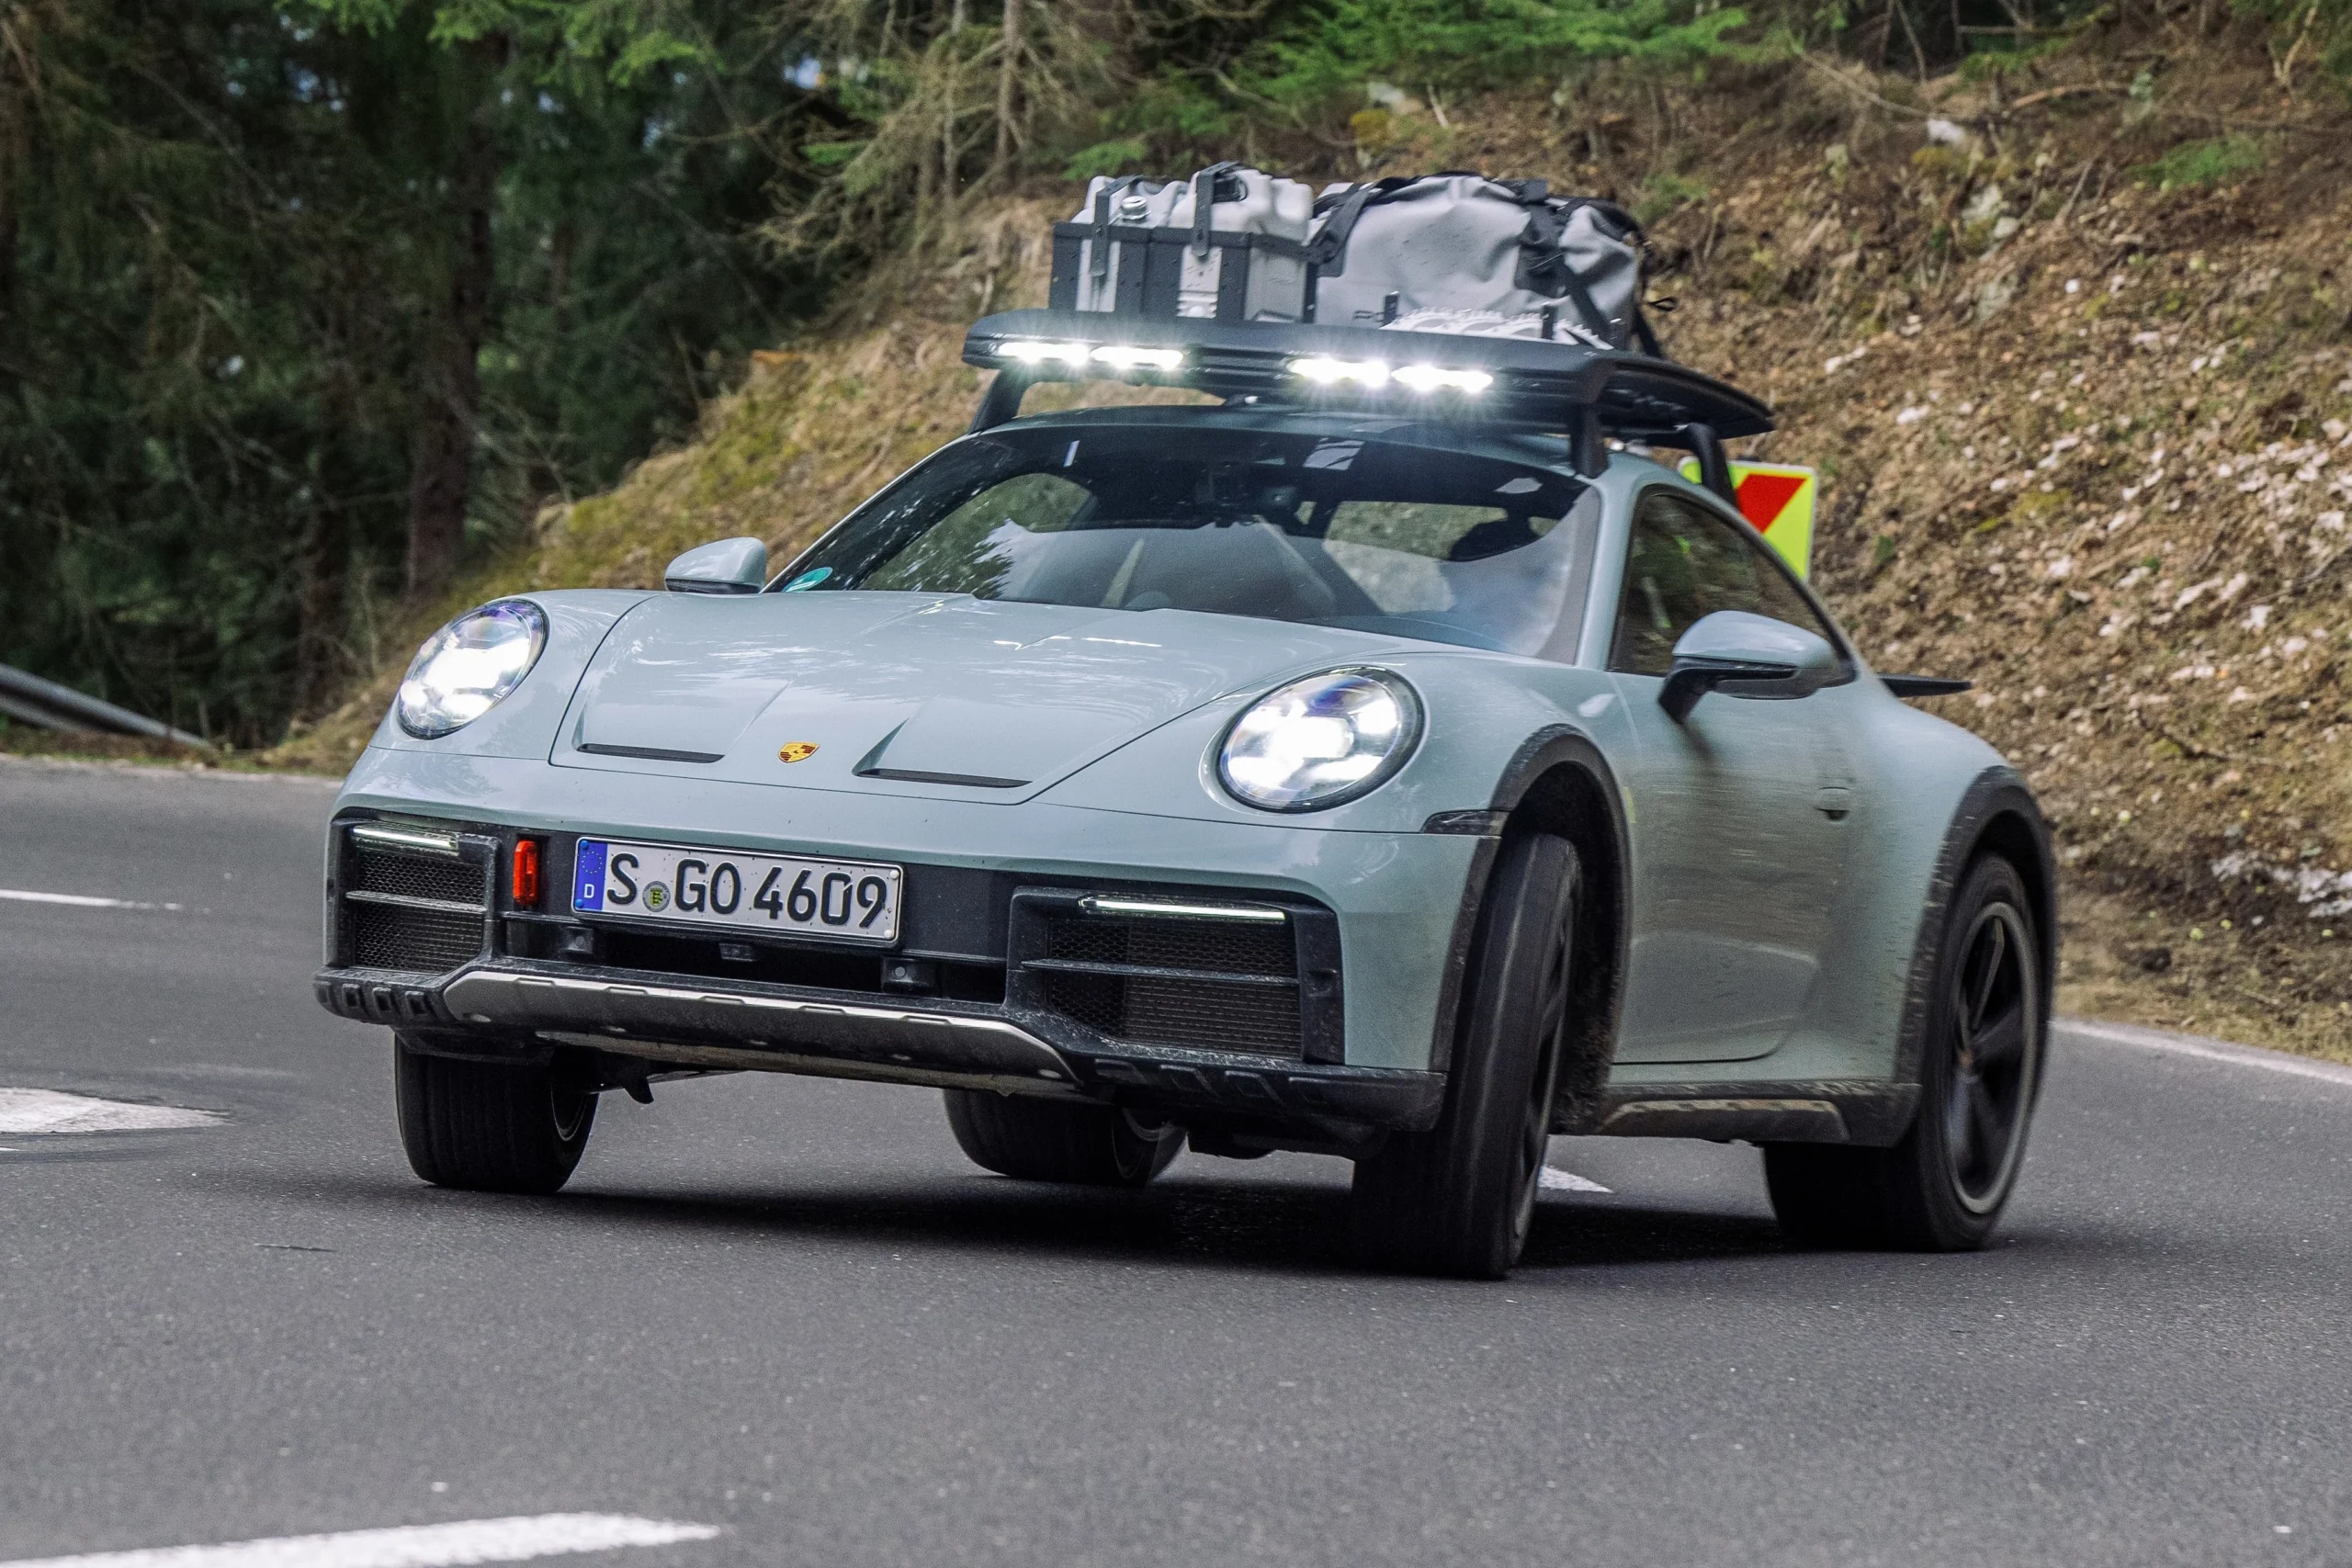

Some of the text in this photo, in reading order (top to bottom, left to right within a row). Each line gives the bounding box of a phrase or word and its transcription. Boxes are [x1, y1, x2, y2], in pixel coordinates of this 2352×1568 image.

[583, 883, 594, 898] D
[607, 852, 639, 905] S
[675, 858, 741, 915] GO
[753, 866, 888, 929] 4609
